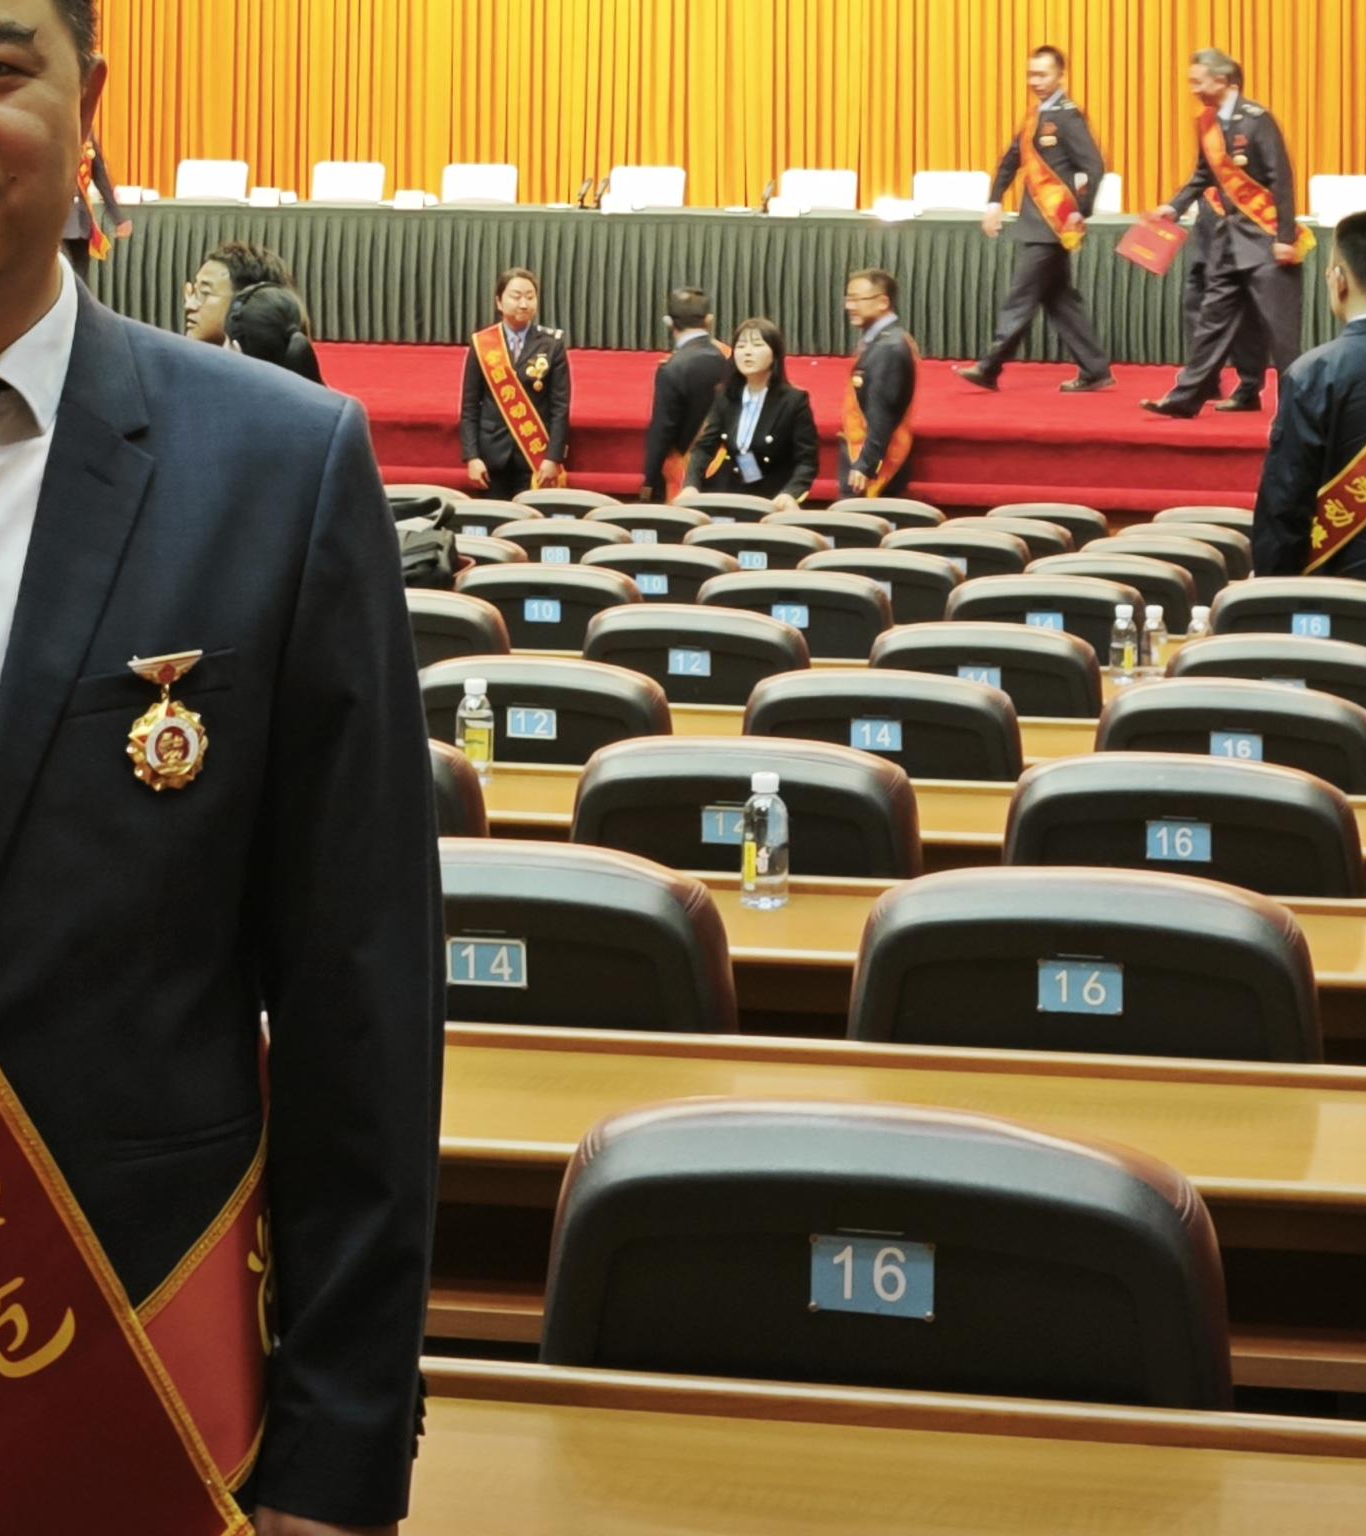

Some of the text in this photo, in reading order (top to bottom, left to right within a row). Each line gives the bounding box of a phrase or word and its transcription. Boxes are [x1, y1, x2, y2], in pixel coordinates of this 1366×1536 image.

[641, 576, 661, 591] 10
[531, 602, 553, 620] 10
[780, 607, 801, 625] 12
[1299, 616, 1322, 635] 16
[676, 654, 702, 674] 12
[516, 713, 549, 734] 12
[862, 724, 892, 747] 14
[1222, 739, 1252, 759] 16
[1157, 826, 1193, 858] 16
[460, 944, 513, 981] 14
[1055, 969, 1107, 1006] 16
[832, 1245, 907, 1303] 16
